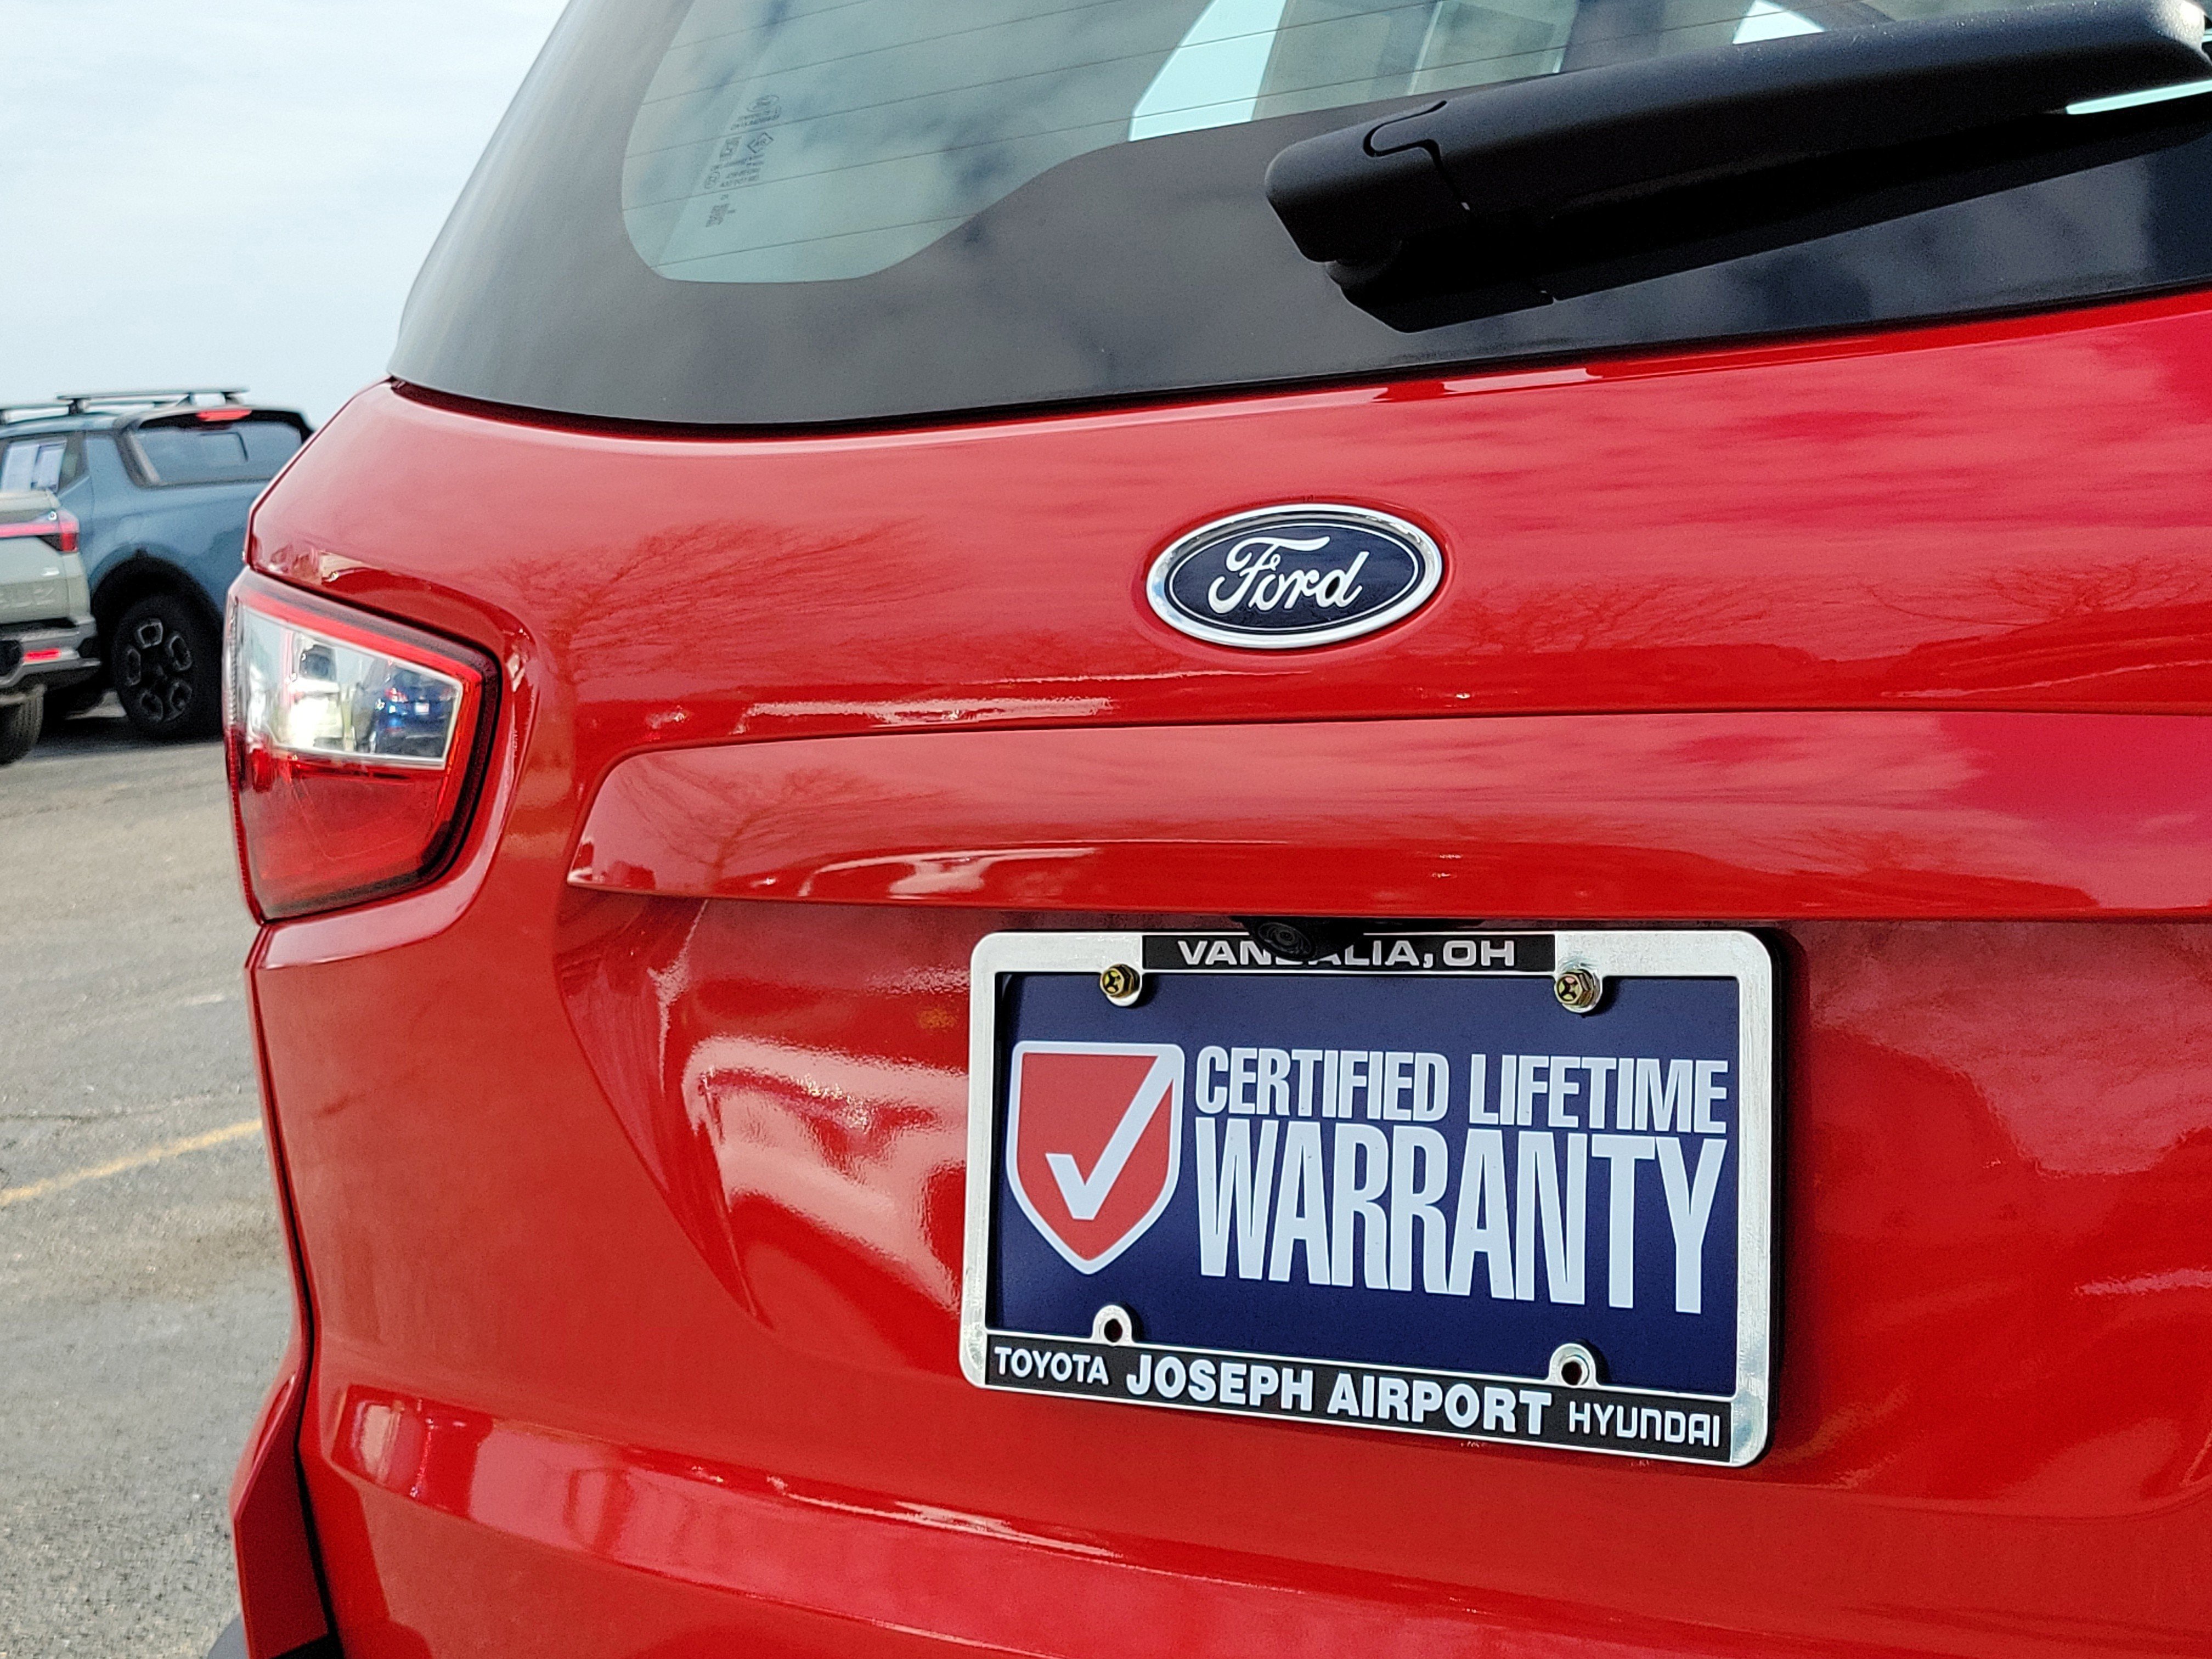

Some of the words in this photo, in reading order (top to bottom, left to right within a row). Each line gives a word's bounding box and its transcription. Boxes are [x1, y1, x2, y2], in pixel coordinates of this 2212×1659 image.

[1208, 536, 1370, 614] Ford
[1177, 940, 1515, 968] VANLIA,OH
[1195, 1046, 1449, 1122] CERTIFIED
[1469, 1053, 1728, 1133] LIFETIME
[1195, 1116, 1727, 1314] WARRANTY
[994, 1346, 1109, 1386] TOYOTA
[1126, 1354, 1313, 1412] JOSEPH
[1327, 1373, 1551, 1435] AIRPORT
[1570, 1401, 1720, 1448] HYUNDAI
